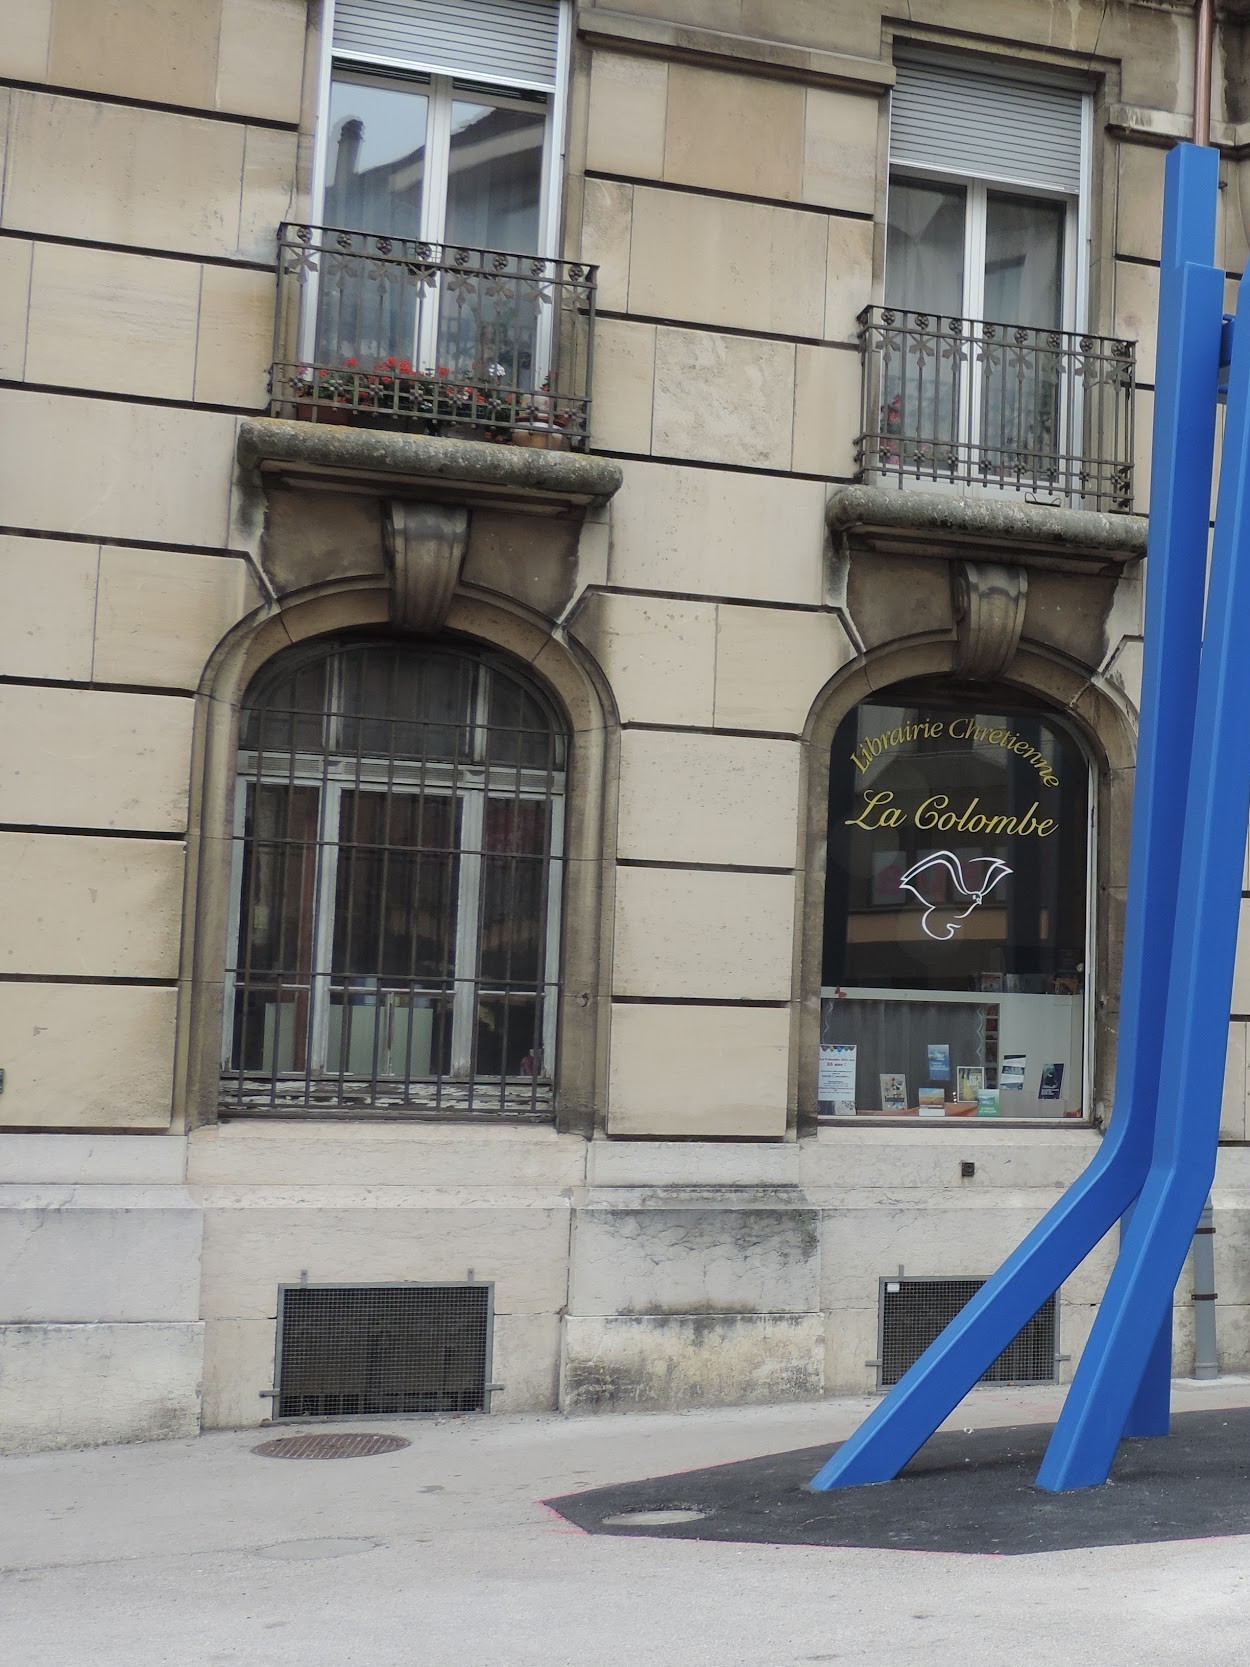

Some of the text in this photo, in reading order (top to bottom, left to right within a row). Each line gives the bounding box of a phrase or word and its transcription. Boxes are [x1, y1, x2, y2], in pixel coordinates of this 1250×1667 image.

[850, 717, 943, 775] Librairie
[845, 789, 1059, 837] La Colombe
